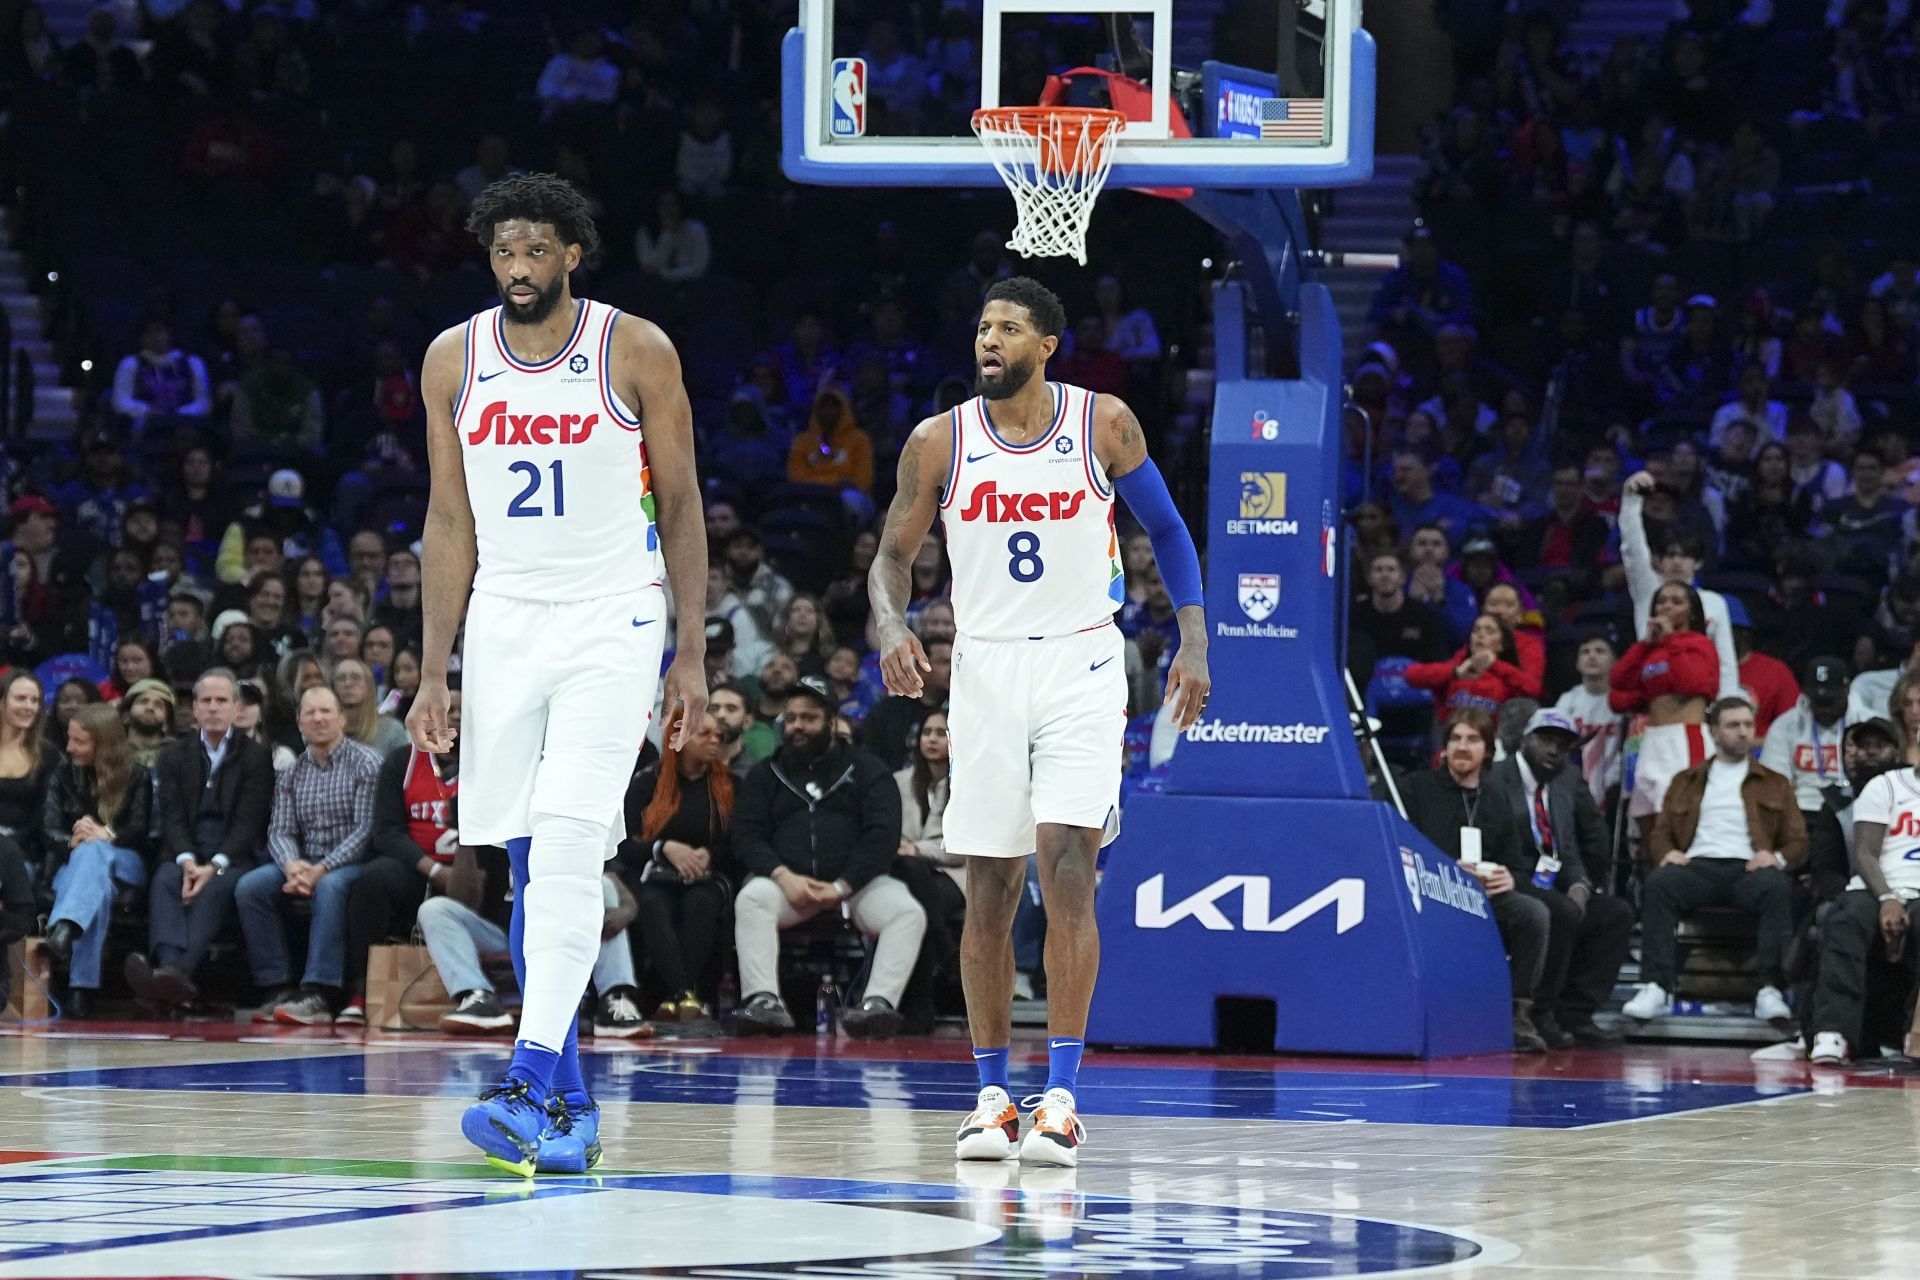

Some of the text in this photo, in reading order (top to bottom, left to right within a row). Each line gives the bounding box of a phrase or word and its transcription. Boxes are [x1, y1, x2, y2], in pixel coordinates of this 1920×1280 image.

[835, 118, 851, 132] NBA
[468, 400, 599, 446] Sixers
[507, 459, 564, 517] 21
[960, 480, 1086, 523] Sixers
[1227, 520, 1298, 535] BETMGM
[1007, 530, 1044, 583] 8
[1185, 718, 1329, 743] ticketmaster
[1135, 873, 1366, 935] KIA
